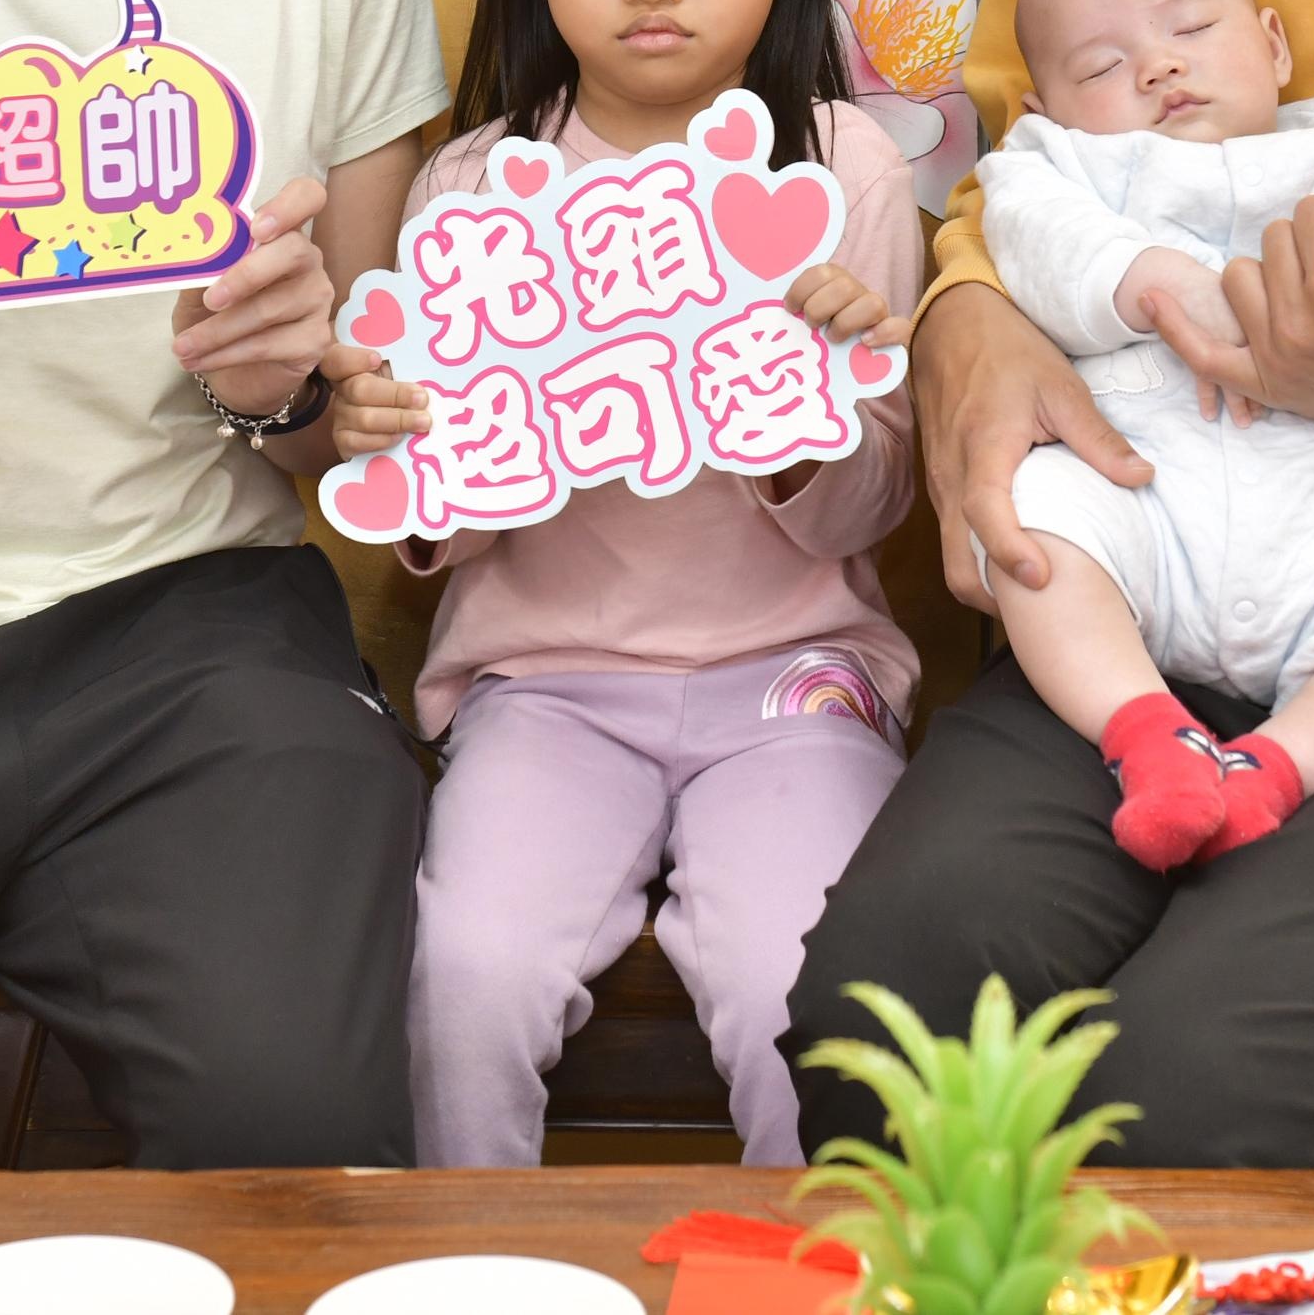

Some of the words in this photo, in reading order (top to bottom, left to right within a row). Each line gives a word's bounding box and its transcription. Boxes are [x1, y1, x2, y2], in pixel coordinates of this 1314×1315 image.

[412, 158, 727, 366] 光頭
[406, 299, 848, 529] 超可愛
